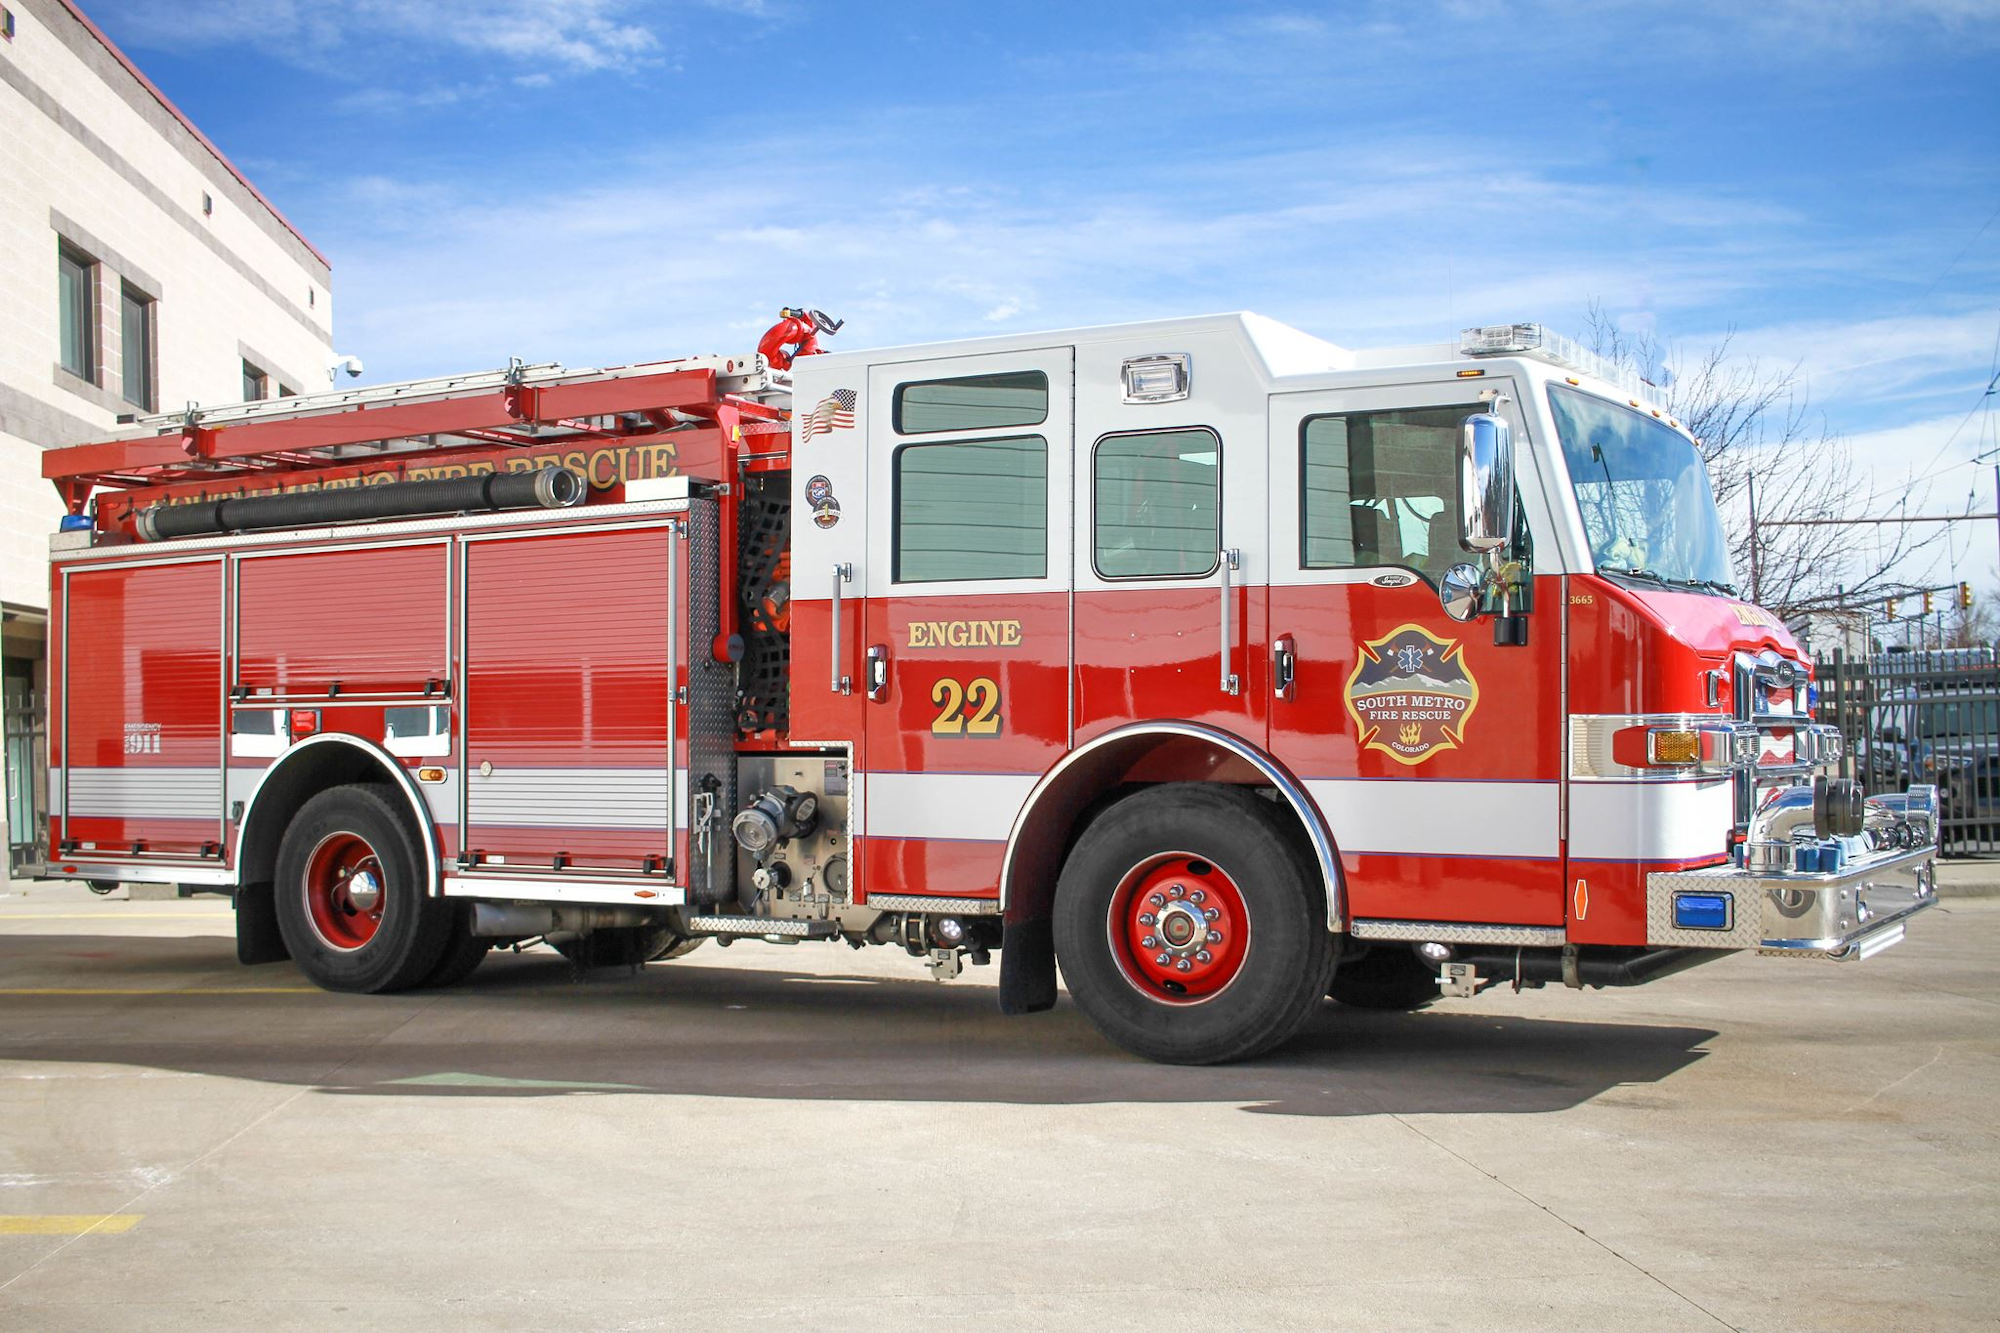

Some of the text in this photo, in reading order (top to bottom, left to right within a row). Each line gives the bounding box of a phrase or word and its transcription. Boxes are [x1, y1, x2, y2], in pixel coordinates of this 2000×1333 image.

[1569, 595, 1594, 605] 3665
[907, 620, 1022, 648] ENGINE
[931, 677, 1001, 737] 22
[1356, 695, 1466, 712] SOUTH METRO
[1369, 710, 1452, 720] FIRE RESCUE
[129, 732, 161, 754] 911
[1391, 741, 1430, 753] COLORADO
